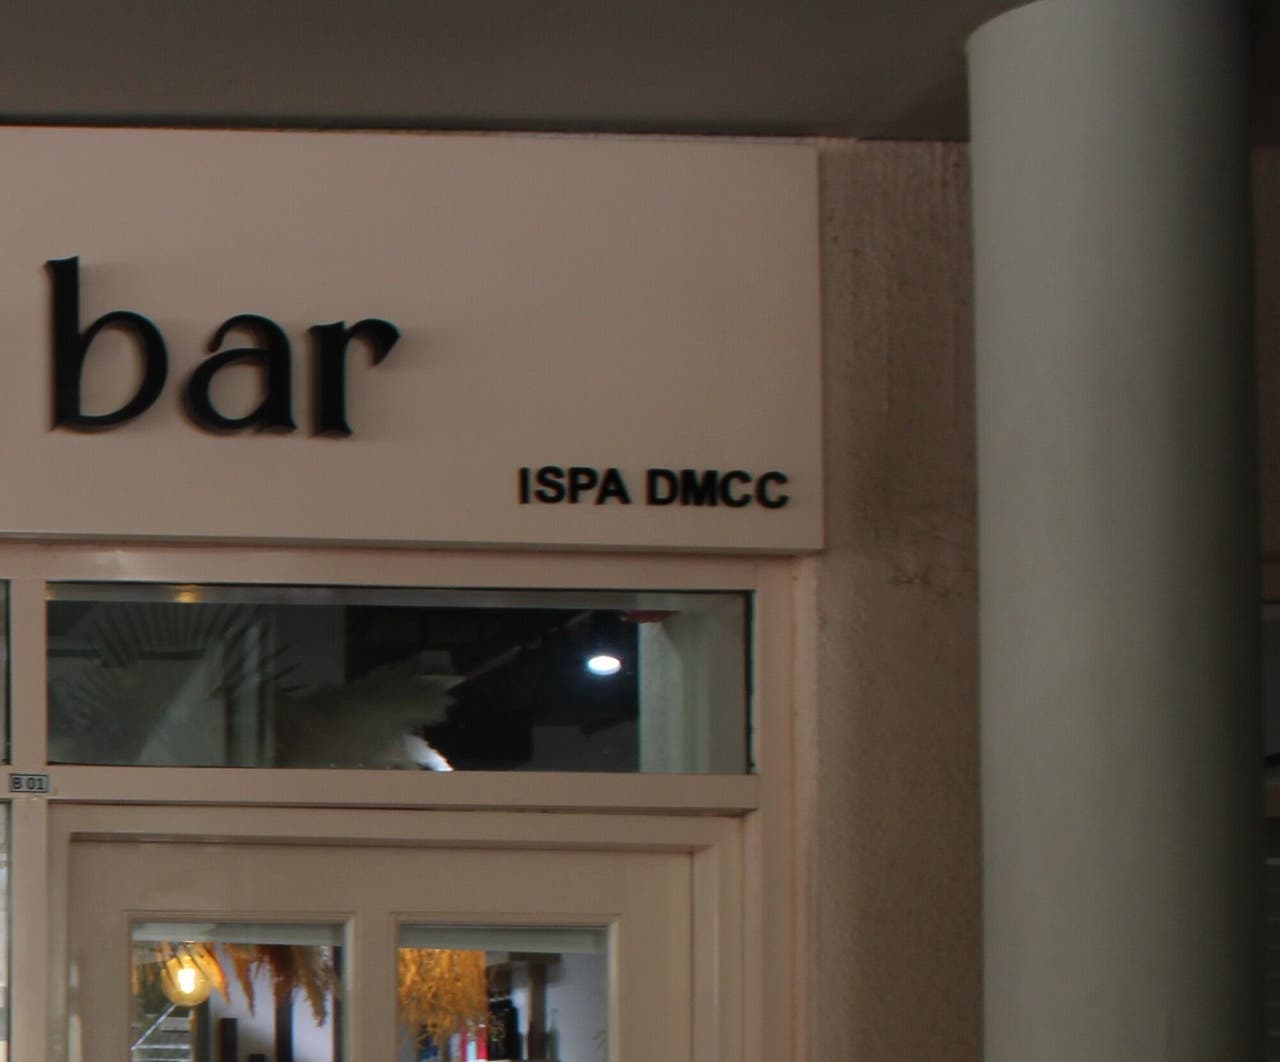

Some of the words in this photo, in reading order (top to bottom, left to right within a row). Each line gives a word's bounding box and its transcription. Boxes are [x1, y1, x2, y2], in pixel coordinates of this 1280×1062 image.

[44, 256, 402, 440] bar
[518, 466, 633, 506] ISPA
[645, 468, 790, 510] DMCC
